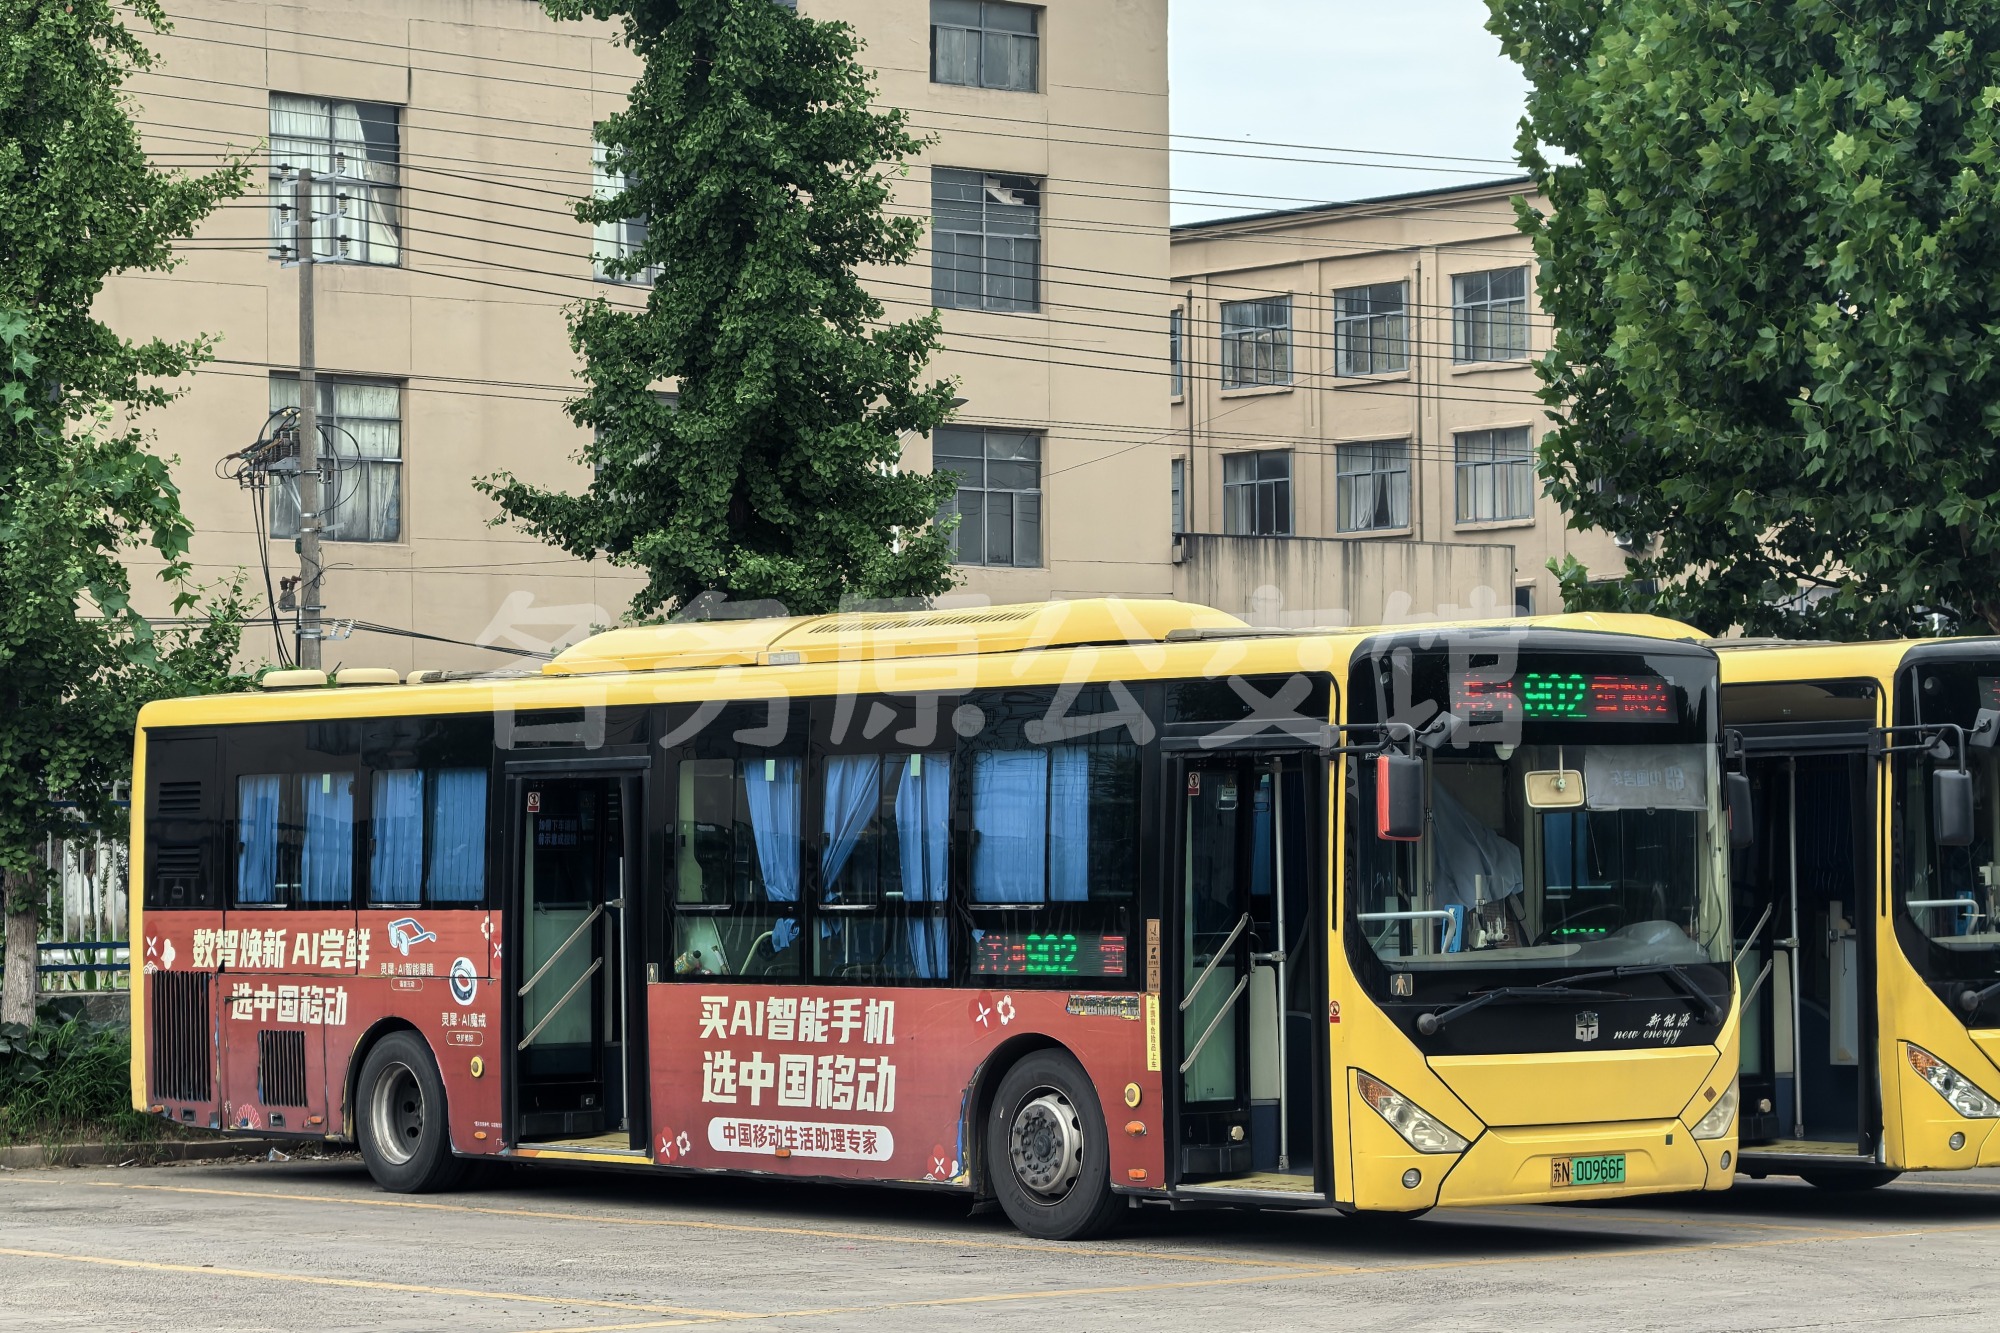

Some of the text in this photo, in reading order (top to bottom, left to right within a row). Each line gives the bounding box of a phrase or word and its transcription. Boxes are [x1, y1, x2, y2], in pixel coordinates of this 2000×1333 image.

[192, 928, 371, 970] 数智焕新 AI尝鲜
[231, 983, 348, 1025] 选中国移动
[699, 995, 895, 1045] 买AI智能手机
[1645, 1012, 1691, 1029] 新能源
[1613, 1027, 1683, 1045] new energy
[702, 1051, 897, 1113] 选中国移动
[722, 1124, 878, 1155] 中国移动生活助理专家
[1576, 1157, 1624, 1184] 00966F
